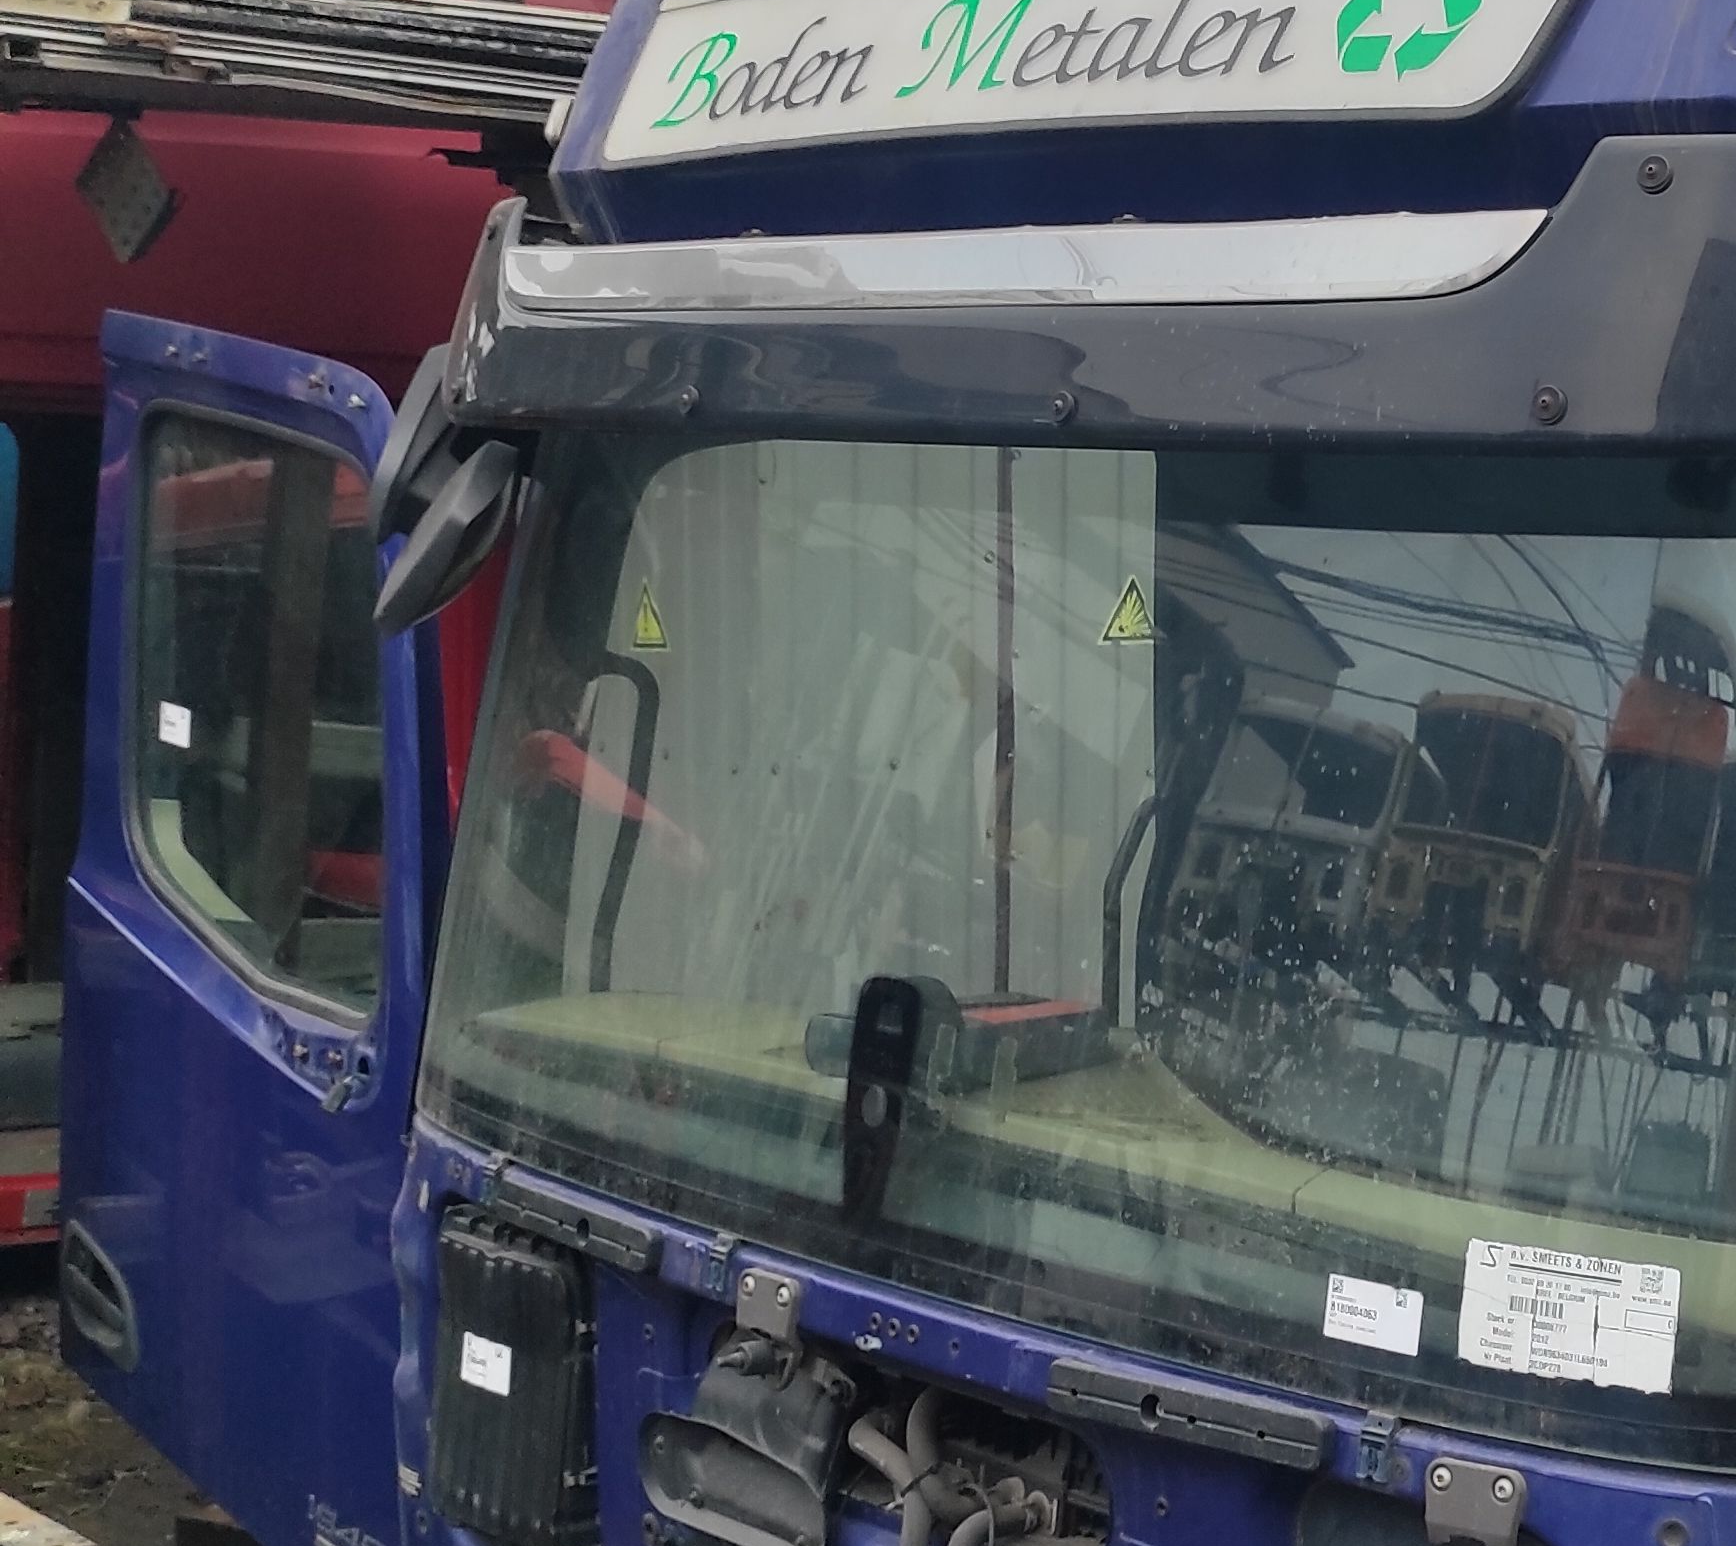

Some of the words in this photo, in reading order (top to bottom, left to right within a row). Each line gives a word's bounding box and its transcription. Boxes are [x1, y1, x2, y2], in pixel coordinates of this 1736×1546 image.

[650, 16, 874, 129] Boden
[1531, 1251, 1572, 1269] SMEETS
[1575, 1257, 1582, 1270] &
[1586, 1259, 1622, 1276] ZONEN
